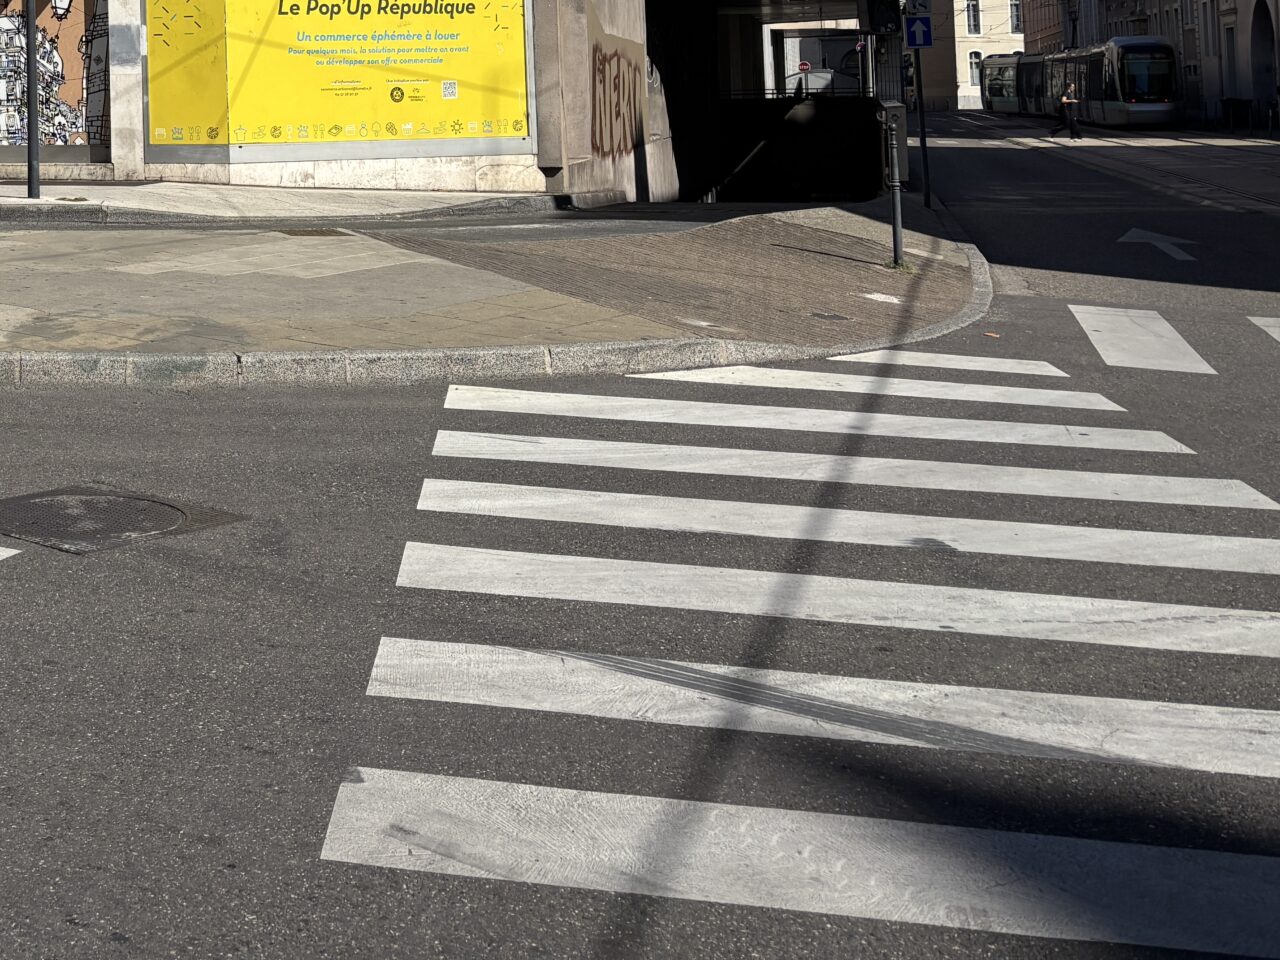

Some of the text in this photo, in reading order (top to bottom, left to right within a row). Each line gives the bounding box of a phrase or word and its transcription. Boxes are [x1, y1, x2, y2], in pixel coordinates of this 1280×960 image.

[297, 30, 460, 43] Un commerce éphémère à louer
[306, 47, 338, 56] quelques
[359, 46, 367, 54] la
[397, 47, 414, 55] pour
[326, 57, 365, 67] développer
[380, 57, 397, 67] offre
[399, 57, 443, 65] commerciale
